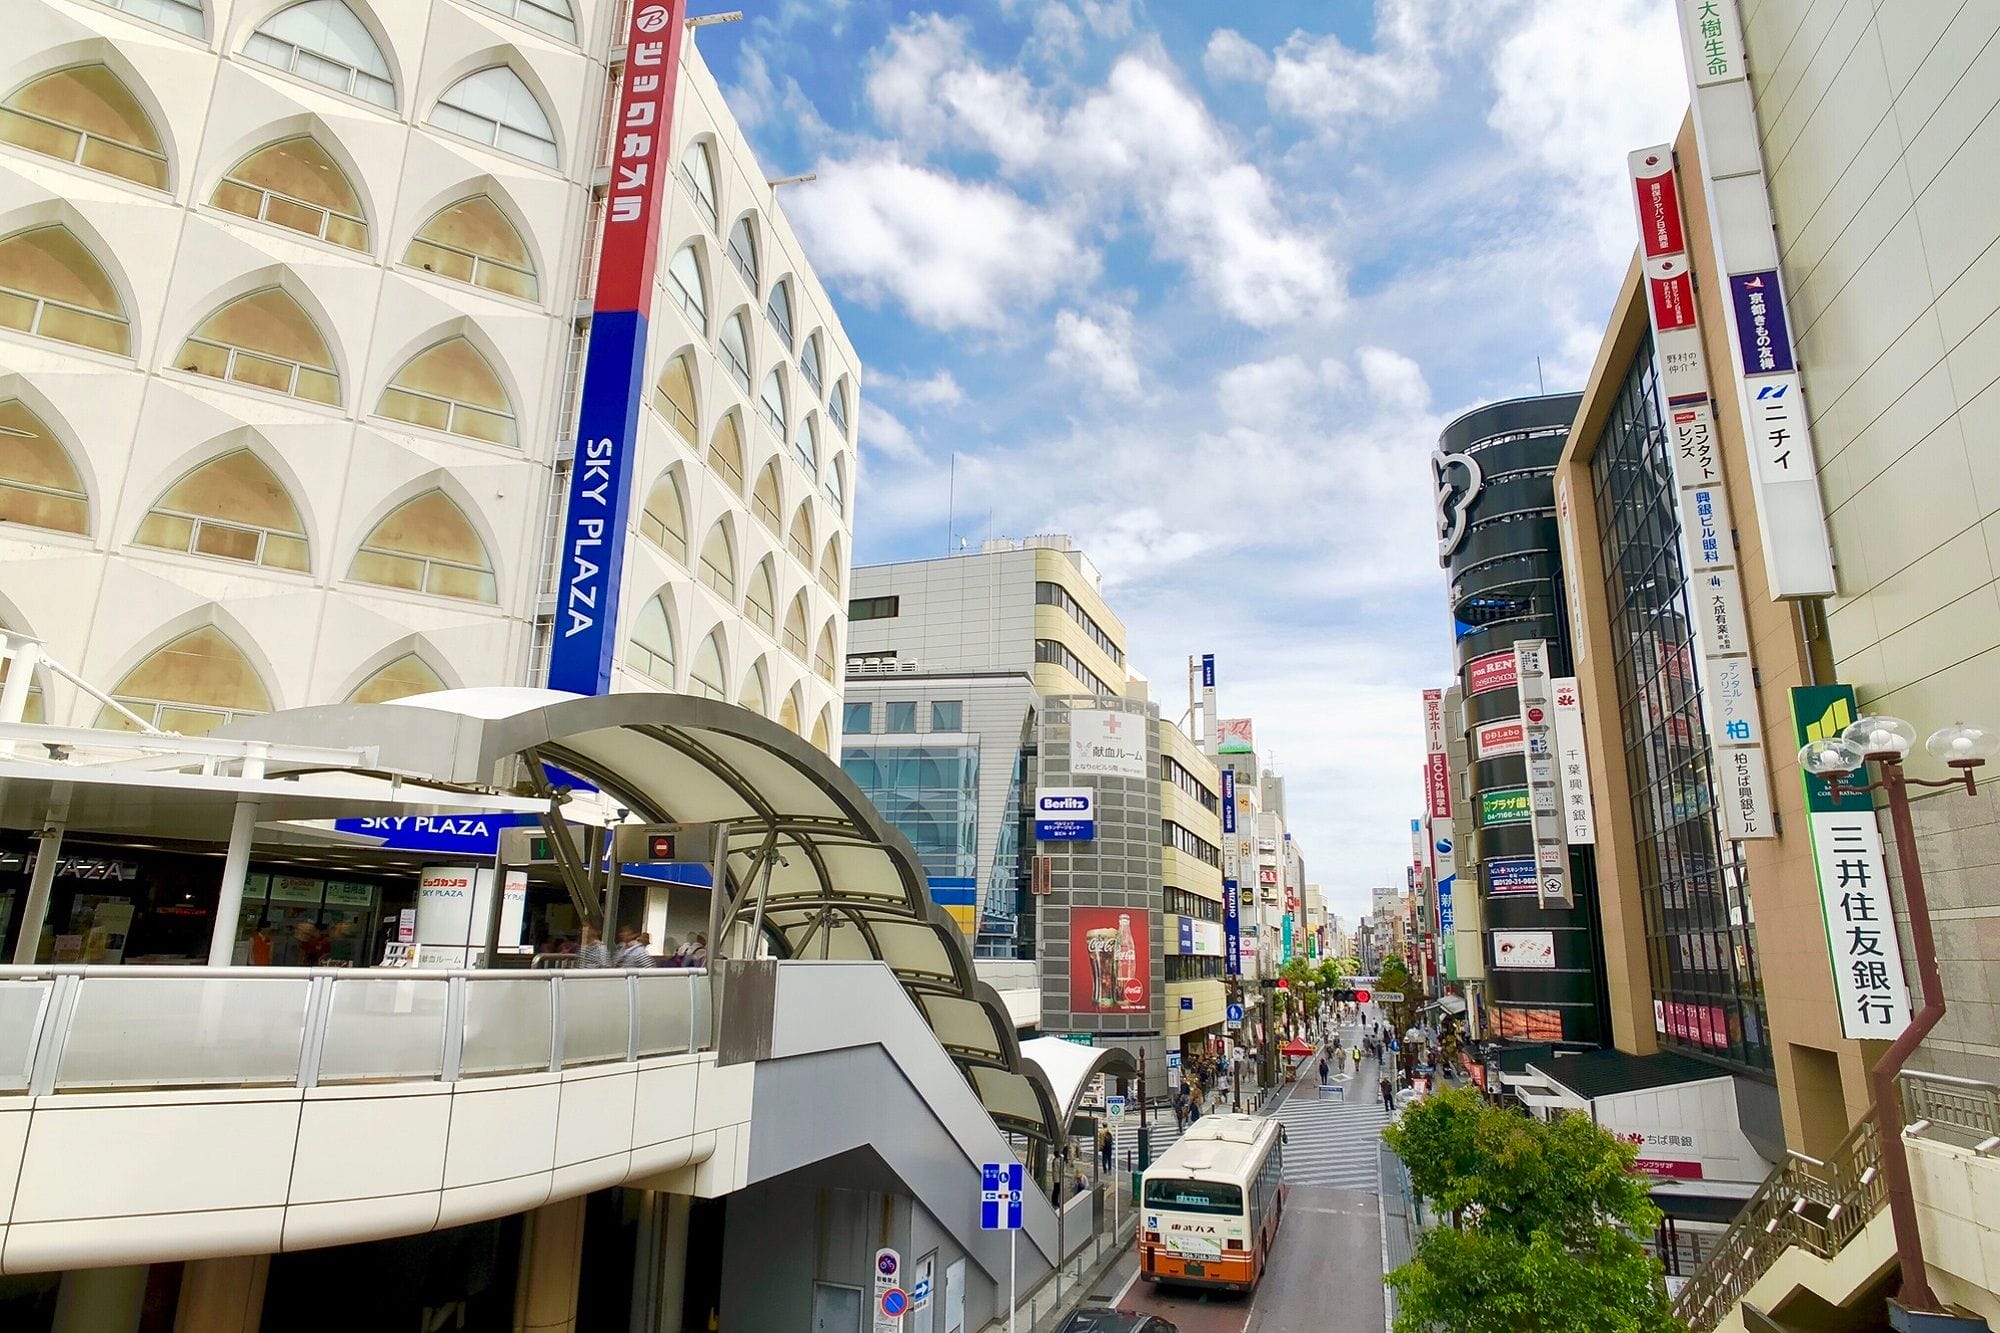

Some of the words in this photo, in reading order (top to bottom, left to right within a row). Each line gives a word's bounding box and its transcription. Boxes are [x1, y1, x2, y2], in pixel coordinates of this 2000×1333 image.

[1698, 1, 1728, 75] 大樹生命
[611, 41, 663, 223] ビックカメラ
[1748, 292, 1776, 370] 京都きもの友禅
[1667, 352, 1697, 364] 野村の
[1678, 426, 1695, 459] レンズ
[1694, 424, 1715, 480] コンタクト
[1765, 404, 1792, 471] ニチイ
[581, 437, 613, 507] SKY
[1695, 491, 1719, 563] 興銀ビル眼科
[565, 518, 605, 638] PLAZA
[1712, 595, 1729, 634] 大成有楽
[1473, 669, 1486, 678] FOR
[1719, 672, 1734, 716] クリニック
[1728, 662, 1742, 697] デンタル
[1428, 701, 1442, 751] 京北ホール
[1726, 719, 1750, 740] 柏
[1092, 745, 1143, 761] 献血ルーム
[1043, 798, 1085, 809] Berlitz
[1433, 754, 1447, 816] ECC外語学院
[1566, 750, 1587, 838] 千葉興業銀行
[1734, 752, 1758, 834] 柏ちば興銀ビル
[360, 816, 409, 831] SKY
[415, 816, 489, 837] PLAZA
[422, 878, 468, 888] ビックカメラ
[422, 889, 433, 897] SKY
[435, 890, 464, 898] PLAZA
[1228, 887, 1237, 918] MIZUHO
[1831, 826, 1894, 1025] 三井住友銀行
[1647, 1135, 1693, 1148] ちば興銀
